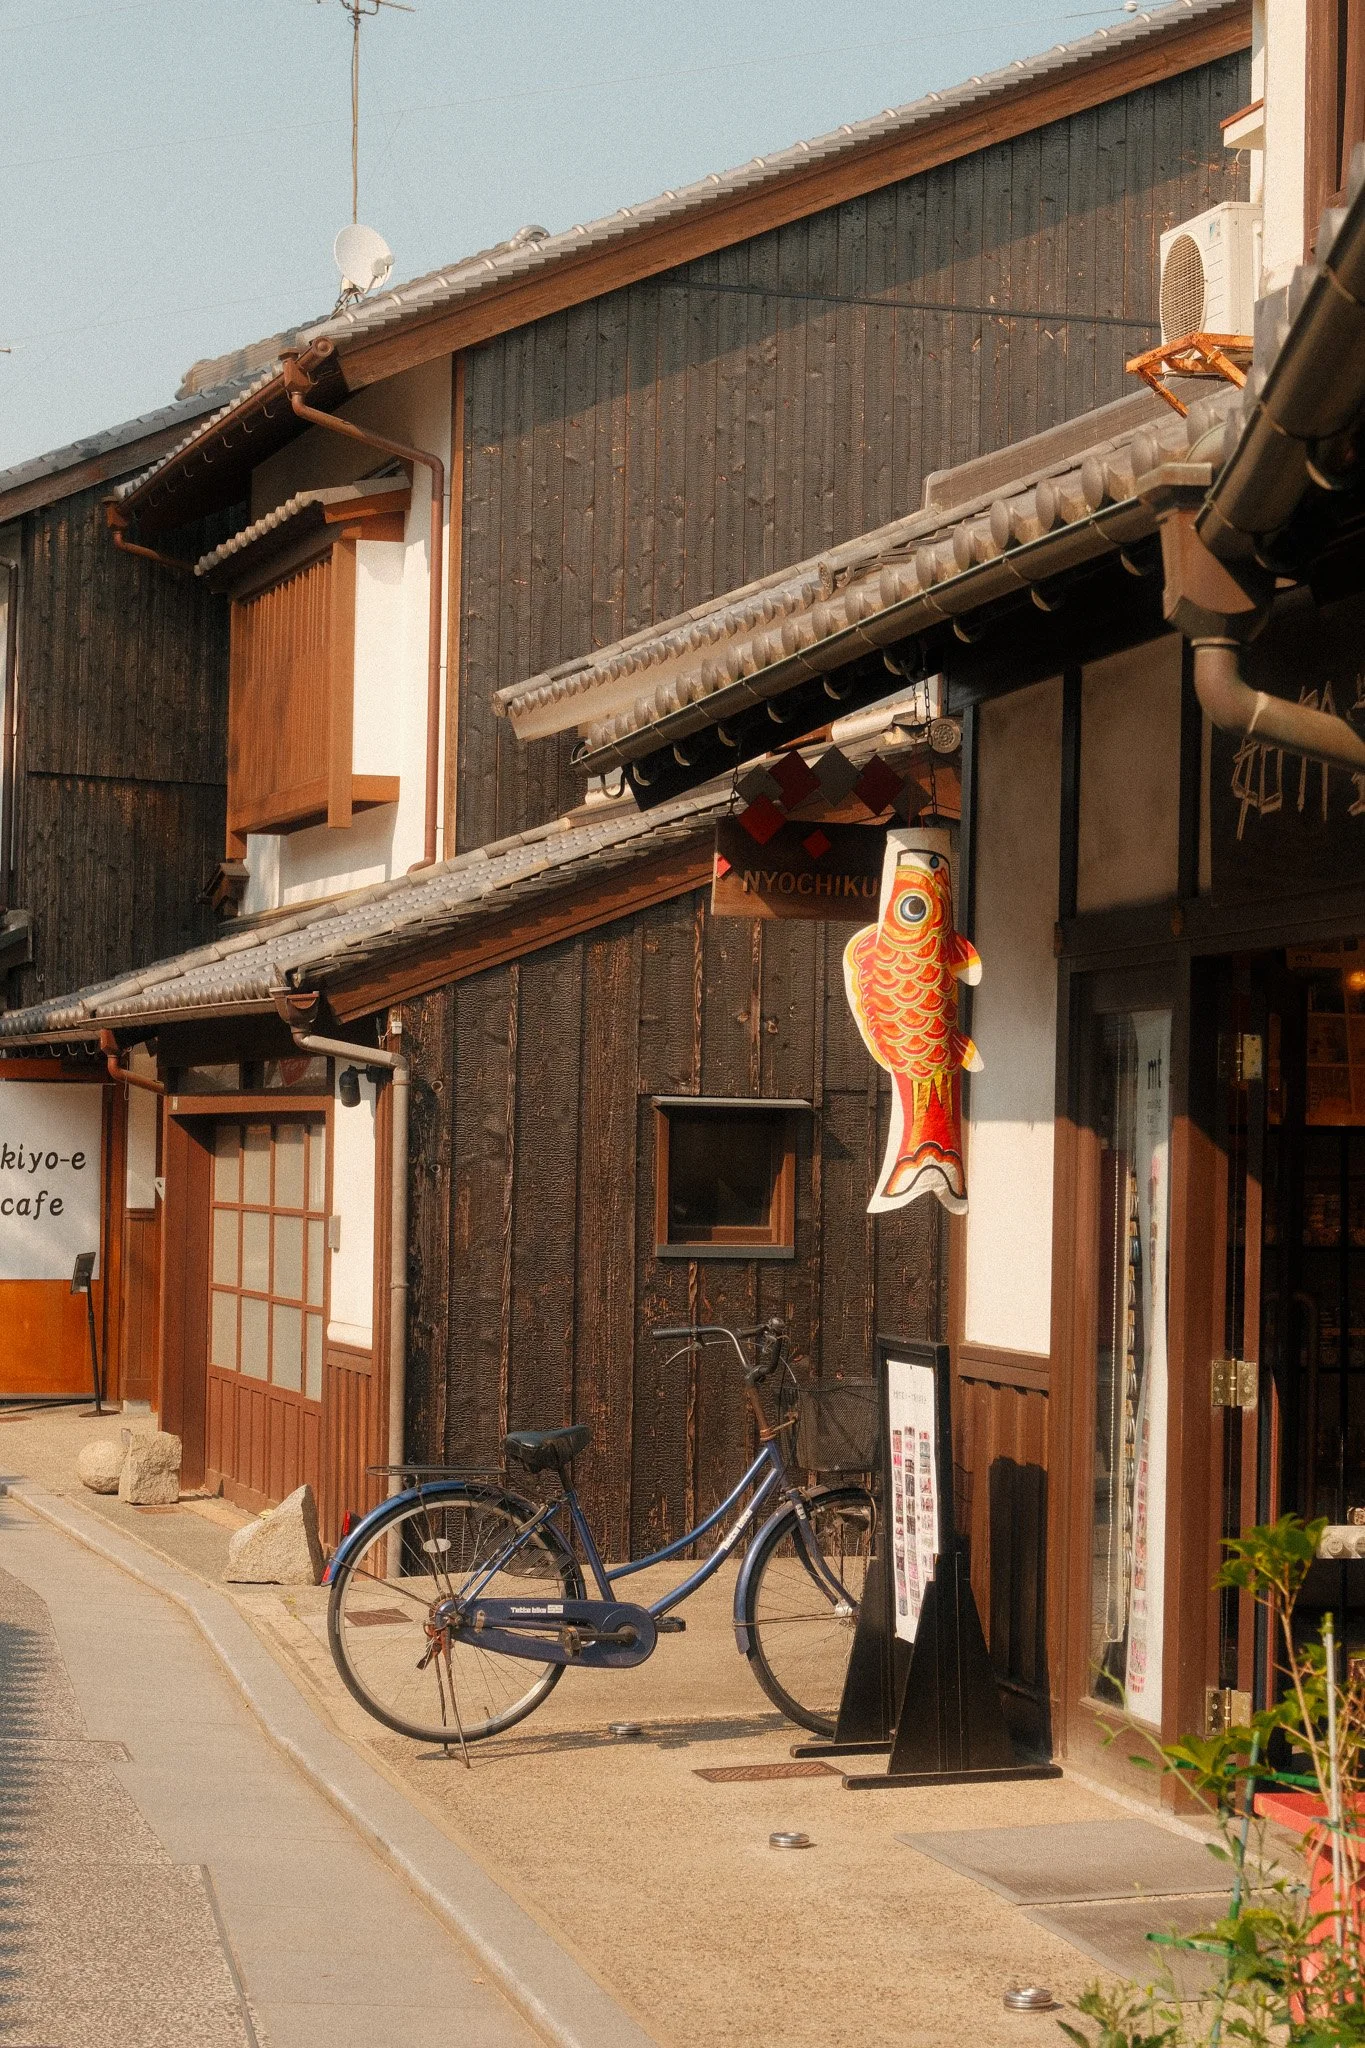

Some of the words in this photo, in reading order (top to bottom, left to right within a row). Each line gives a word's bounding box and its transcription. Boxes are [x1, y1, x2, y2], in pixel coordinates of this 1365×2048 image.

[742, 869, 878, 899] NYOCHIKU
[1147, 1049, 1162, 1090] mt
[0, 1142, 87, 1174] kiyo-e
[0, 1190, 65, 1221] cafe
